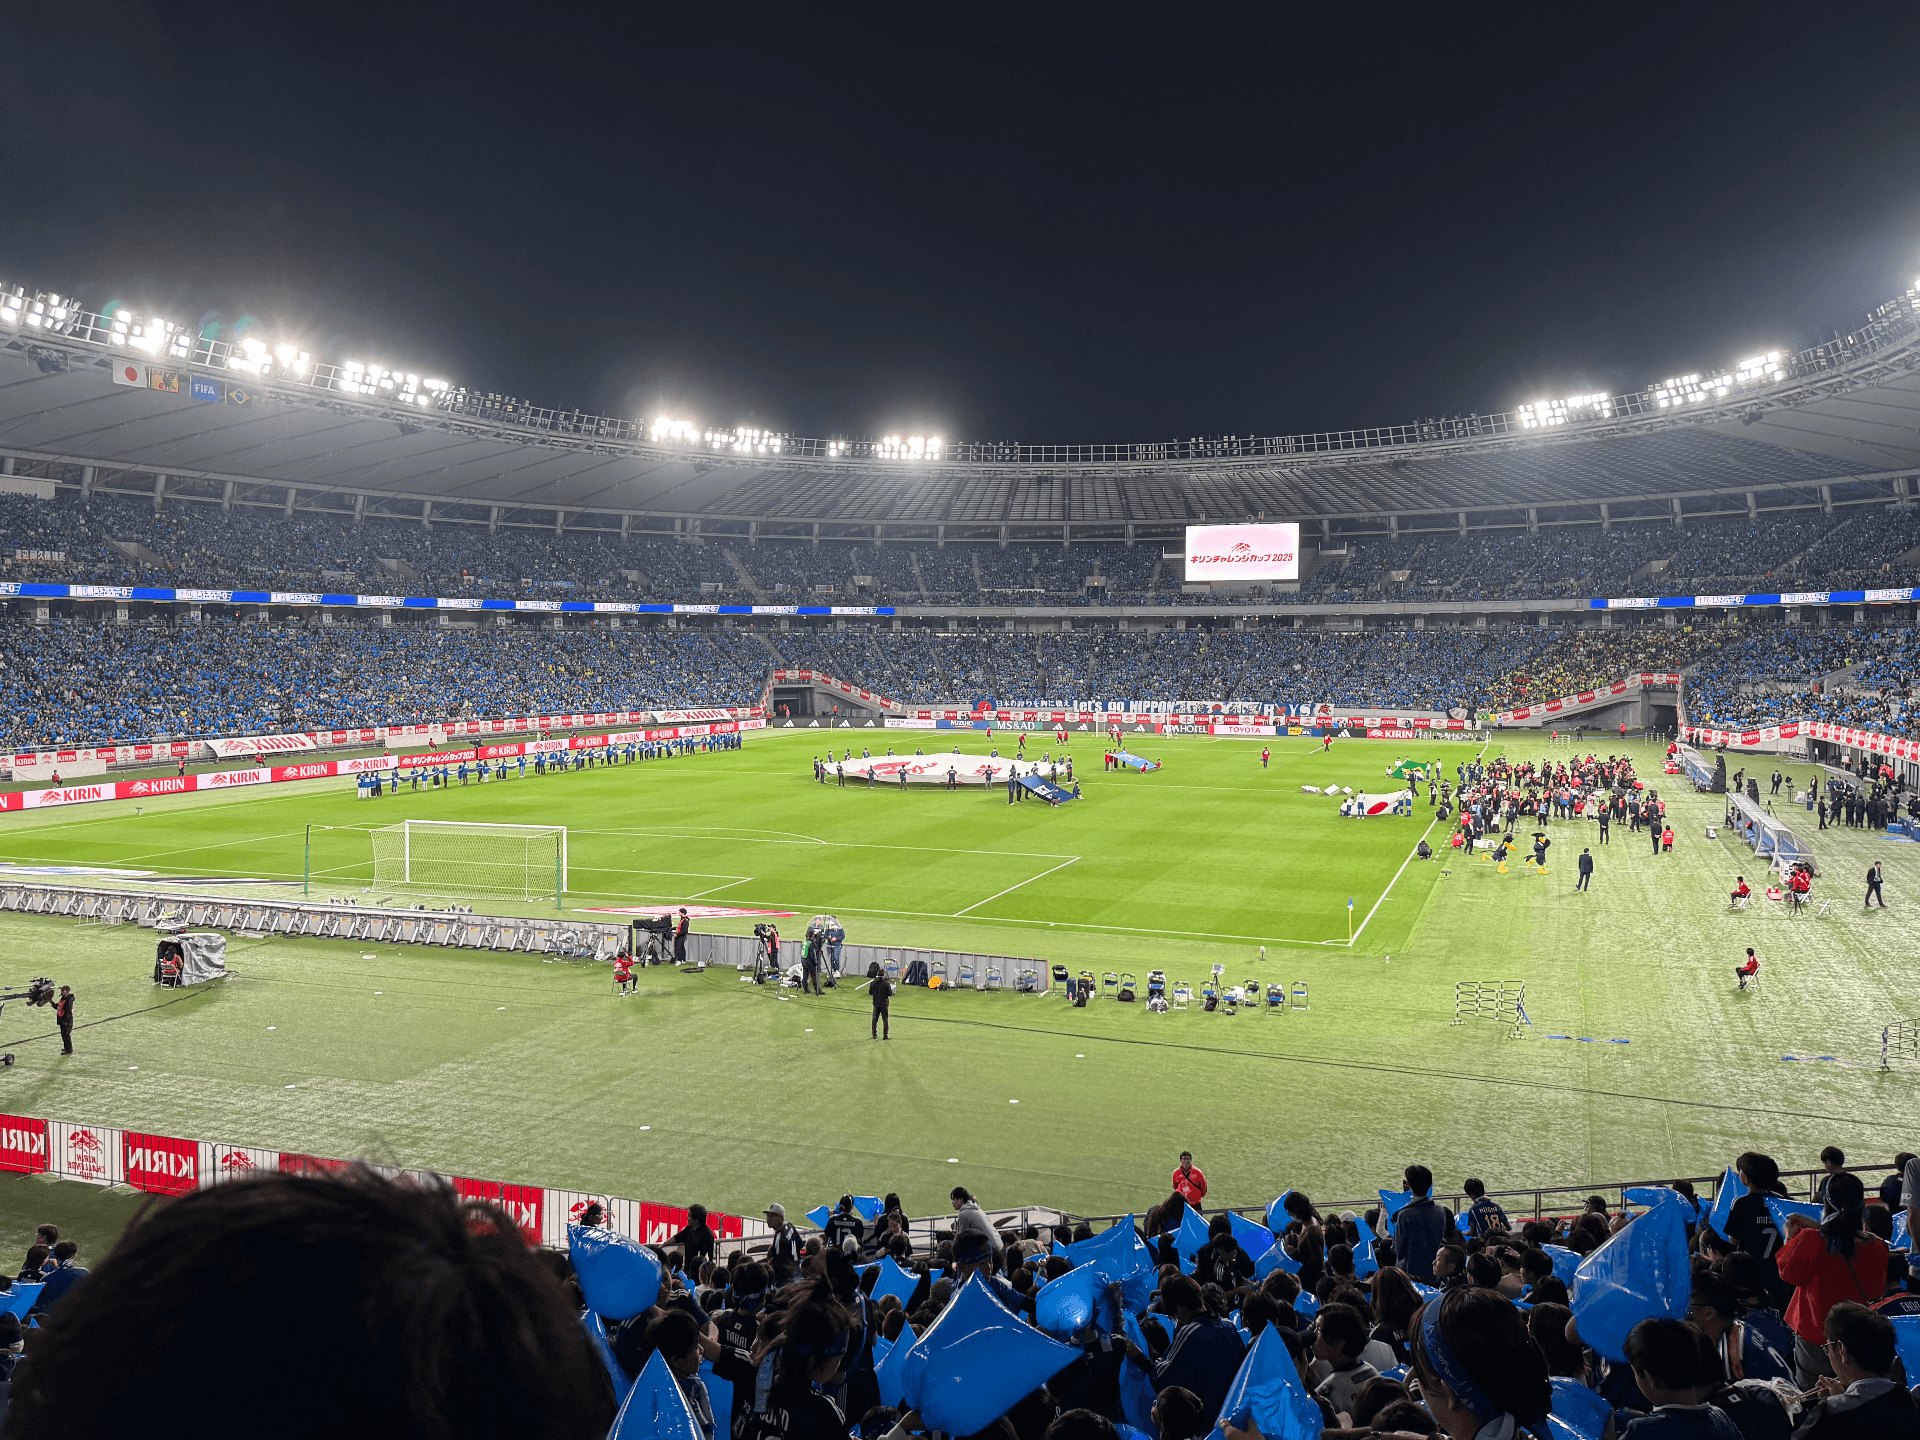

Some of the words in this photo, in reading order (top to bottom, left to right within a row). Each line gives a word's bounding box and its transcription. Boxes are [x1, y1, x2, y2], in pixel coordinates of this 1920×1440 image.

[194, 383, 215, 396] FIFA
[1190, 554, 1271, 564] キリンチャレンジカップ
[1271, 552, 1294, 562] 2025
[1073, 699, 1103, 713] Let's
[1107, 701, 1125, 714] go
[1129, 700, 1175, 714] NIPPON
[682, 709, 725, 720] KIRIN
[415, 726, 429, 734] KIRIN
[443, 725, 455, 733] KIRIN
[997, 721, 1035, 730] MS&AD
[1180, 724, 1208, 734] HOTEL
[1229, 726, 1261, 734] TOYOTA
[1780, 725, 1798, 736] KIRIN
[332, 732, 347, 741] KIRIN
[360, 730, 375, 738] KIRIN
[1385, 729, 1413, 739] KIRIN
[1742, 733, 1760, 742] KIRIN
[249, 735, 307, 751] KIRIN
[544, 740, 563, 751] KIRIN
[585, 736, 603, 746] KIRIN
[135, 748, 152, 757] KIRIN
[171, 745, 189, 754] KIRIN
[498, 744, 519, 756] KIRIN
[57, 753, 76, 763] KIRIN
[97, 751, 116, 759] KIRIN
[16, 757, 36, 766] KIRIN
[364, 757, 389, 770] KIRIN
[300, 763, 328, 777] KIRIN
[229, 770, 260, 785] KIRIN
[151, 777, 185, 794] KIRIN
[63, 786, 102, 801] KIRIN
[1761, 1227, 1778, 1259] 7
[725, 1329, 748, 1349] TAKAI
